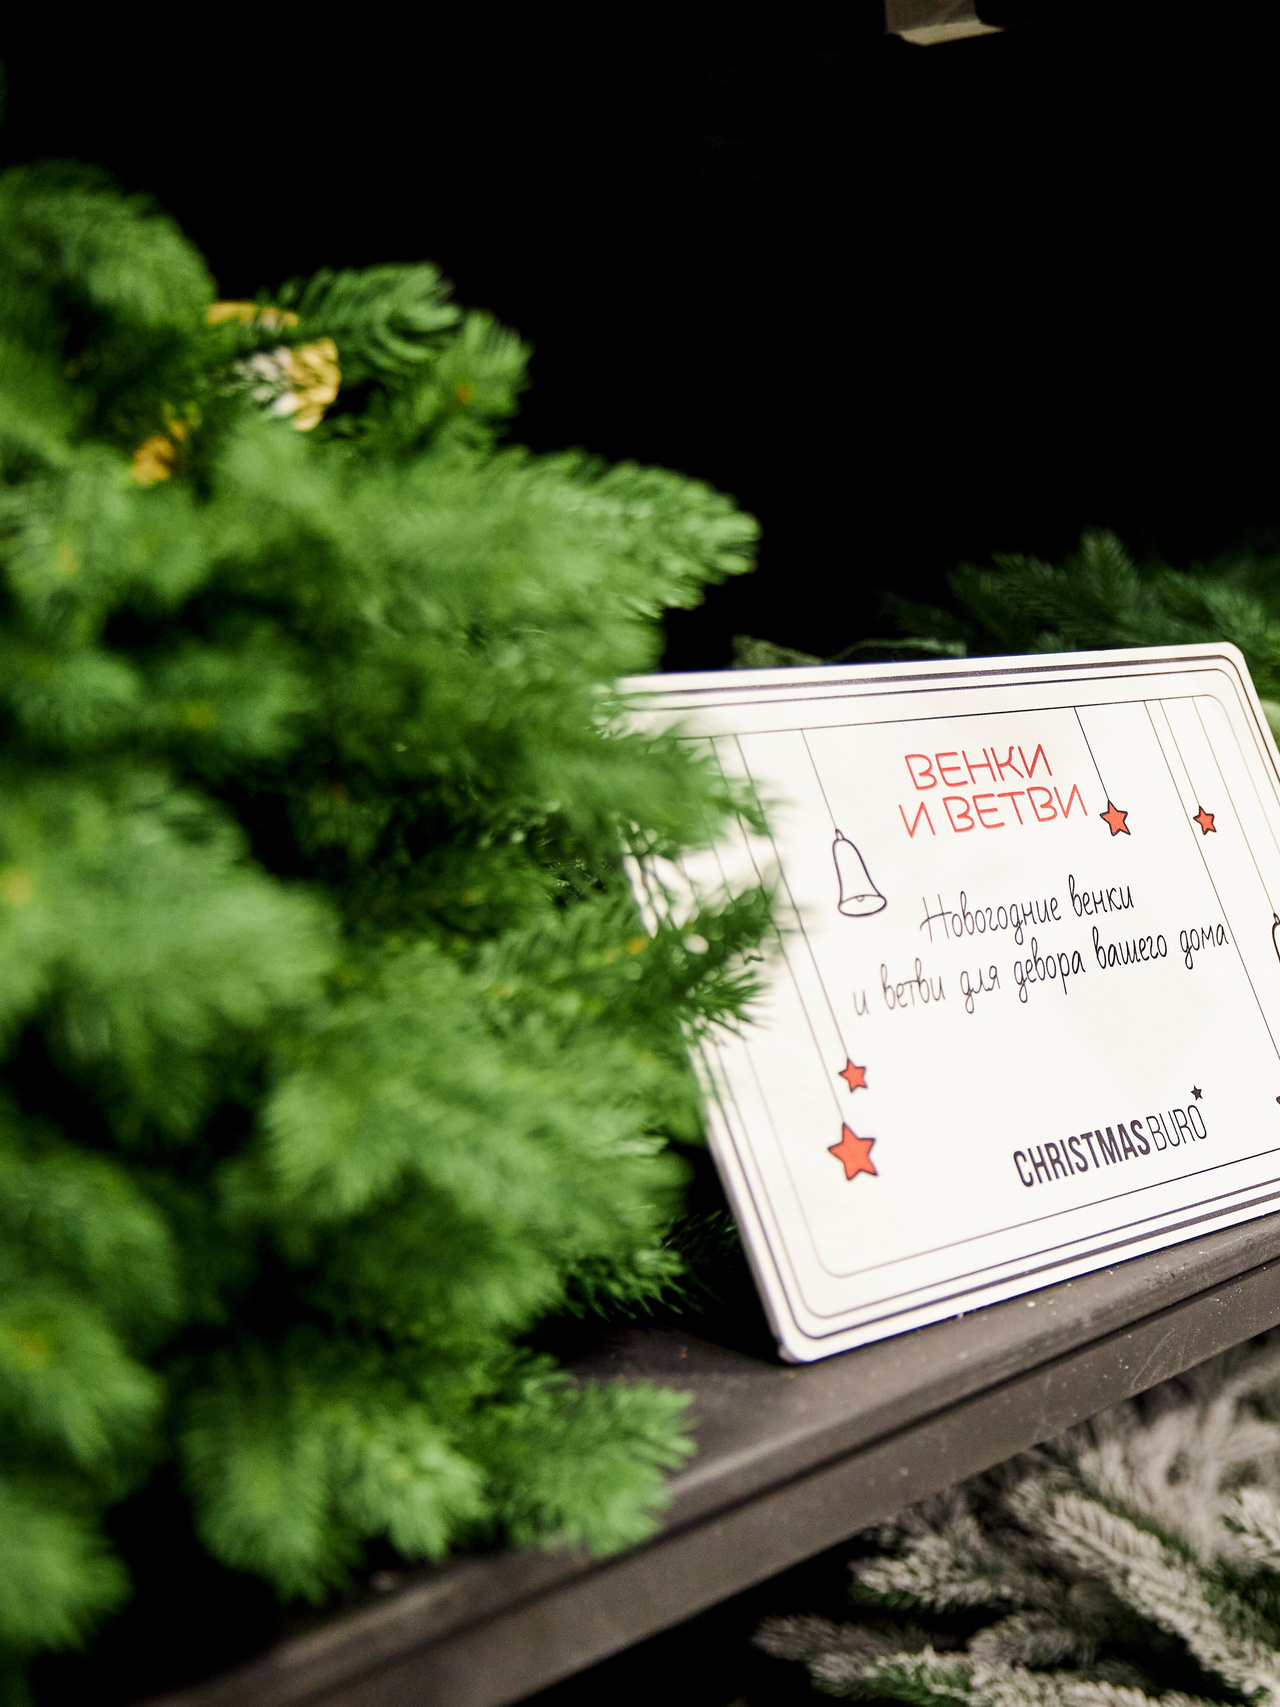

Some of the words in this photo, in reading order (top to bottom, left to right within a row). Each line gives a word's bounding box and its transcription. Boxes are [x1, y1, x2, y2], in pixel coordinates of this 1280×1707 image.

[905, 744, 1052, 791] ВЕНКИ
[899, 802, 936, 838] И
[943, 784, 1088, 833] ВЕТВИ
[920, 891, 1062, 945] Новогодние
[1069, 874, 1134, 916] венки
[852, 988, 870, 1016] и
[881, 958, 946, 1011] ветви
[960, 965, 1001, 1014] для
[1092, 926, 1168, 969] вашего
[1179, 923, 1230, 970] дома
